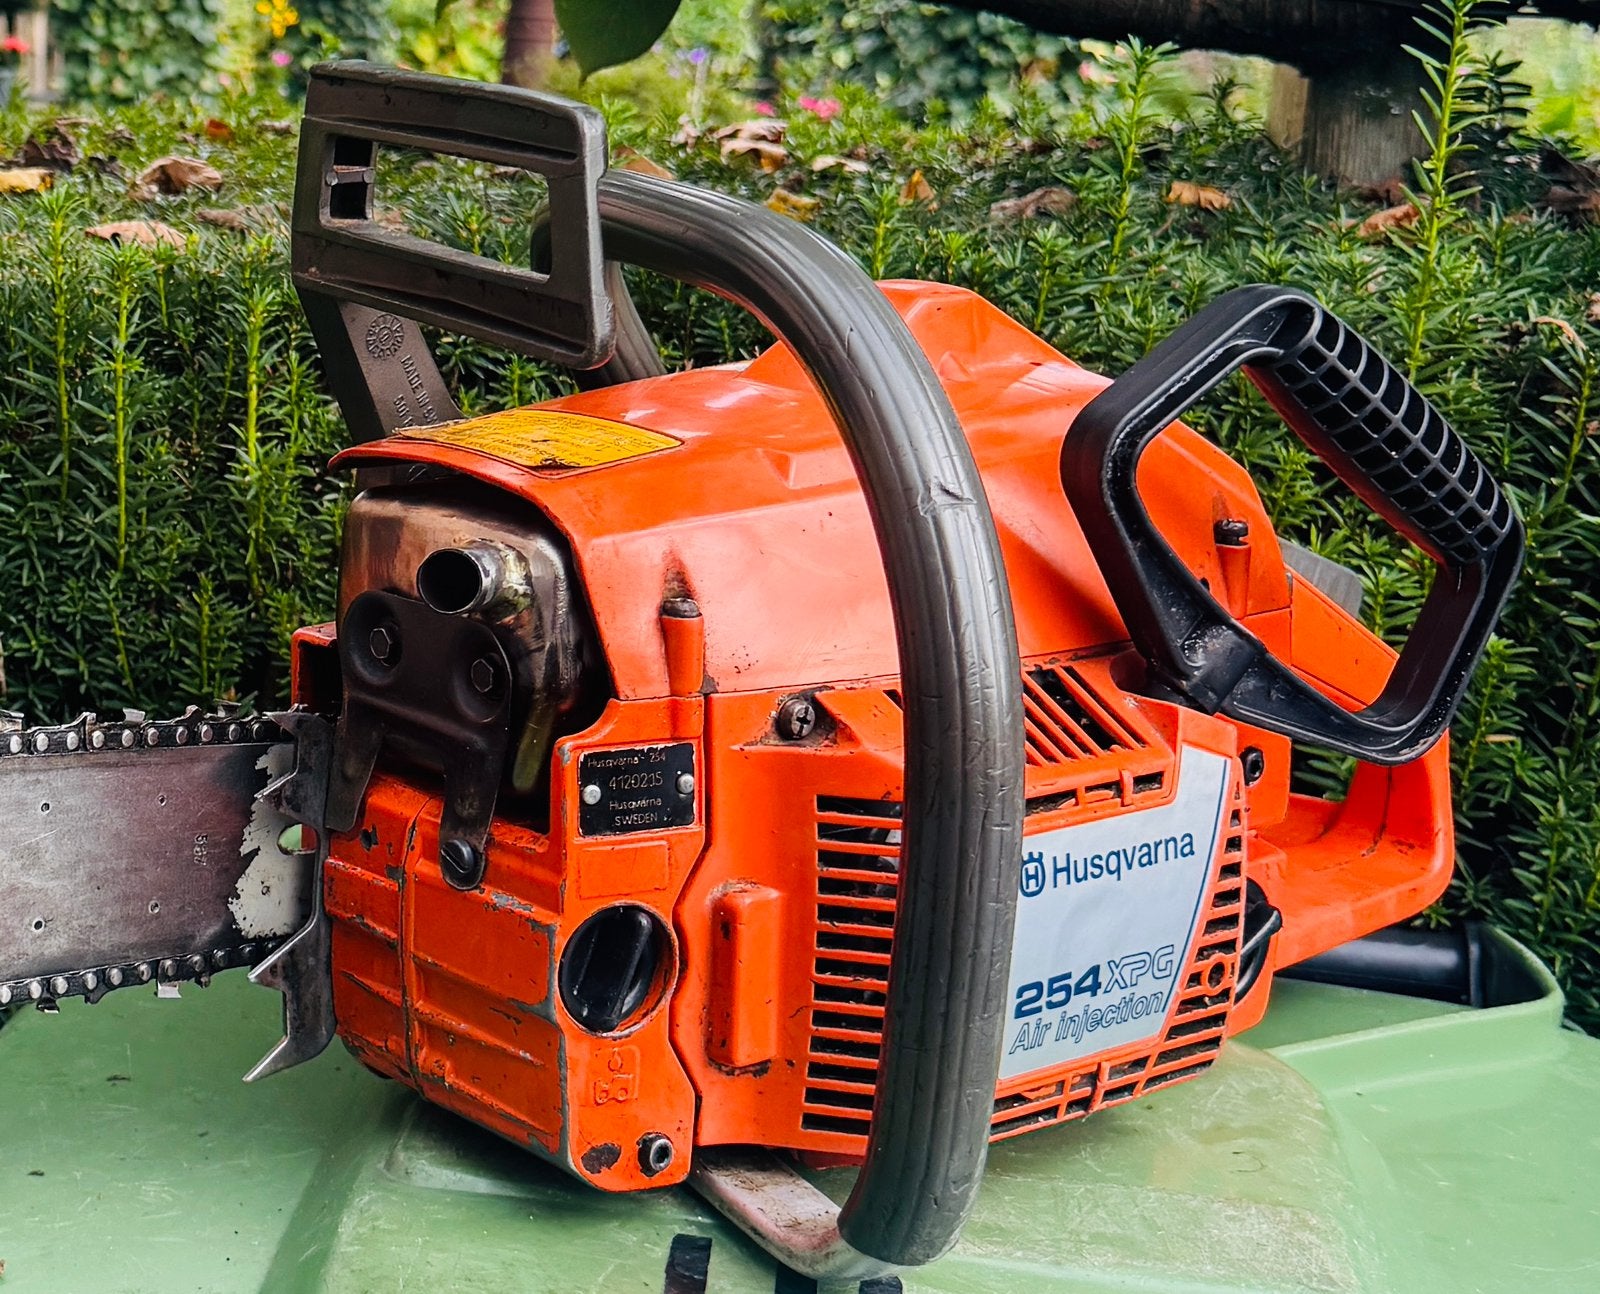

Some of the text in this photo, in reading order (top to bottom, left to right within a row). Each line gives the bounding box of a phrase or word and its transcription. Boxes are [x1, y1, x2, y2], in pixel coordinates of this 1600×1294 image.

[401, 354, 424, 394] MADE
[416, 390, 430, 408] IN
[587, 756, 640, 769] Husqvarna
[609, 798, 662, 811] Husqvarna
[614, 813, 659, 826] SWEDEN
[1052, 832, 1195, 888] Husqvarna
[1008, 990, 1164, 1055] Air injection
